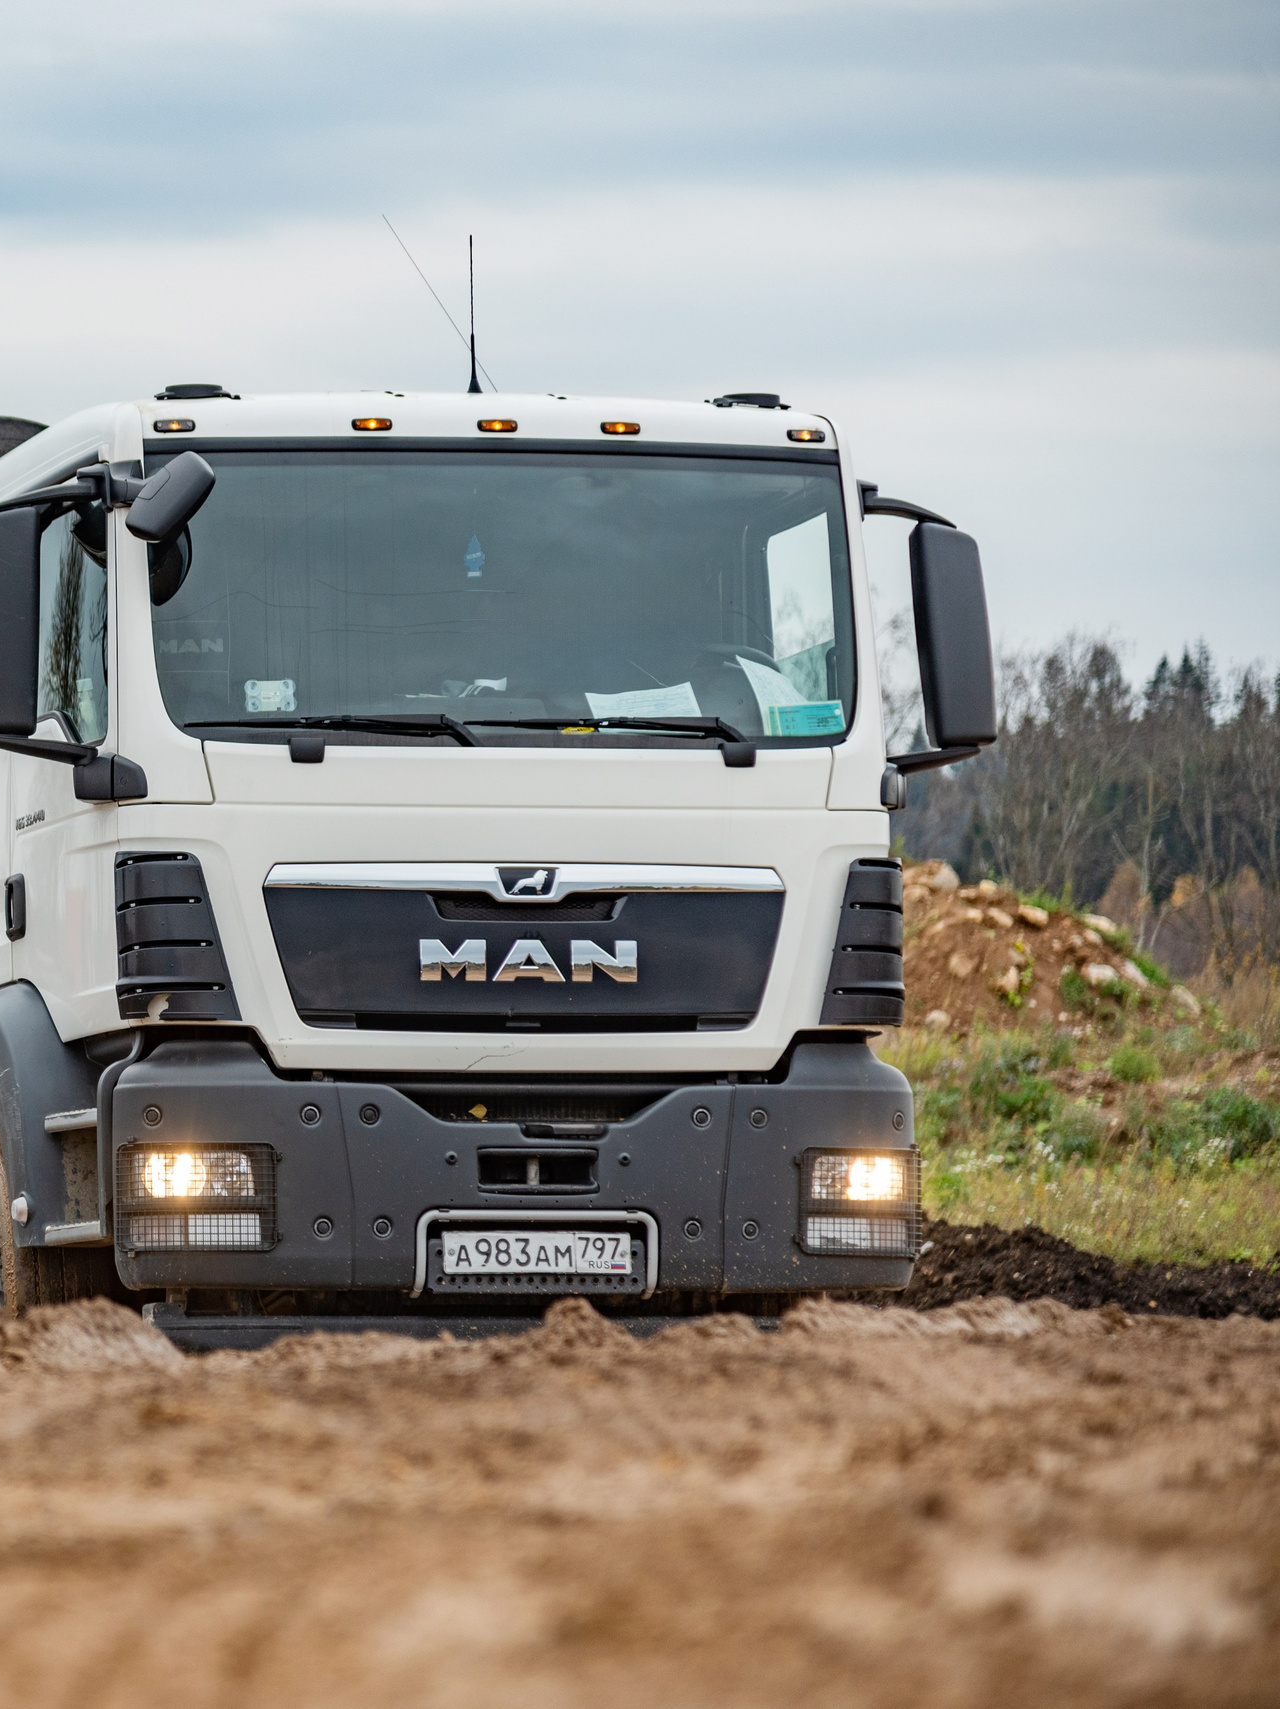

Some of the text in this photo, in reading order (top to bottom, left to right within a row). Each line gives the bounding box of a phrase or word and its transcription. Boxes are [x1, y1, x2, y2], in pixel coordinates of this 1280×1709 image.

[158, 637, 224, 654] MAN
[419, 938, 638, 982] MAN
[577, 1237, 621, 1259] 797
[588, 1260, 610, 1269] RUS
